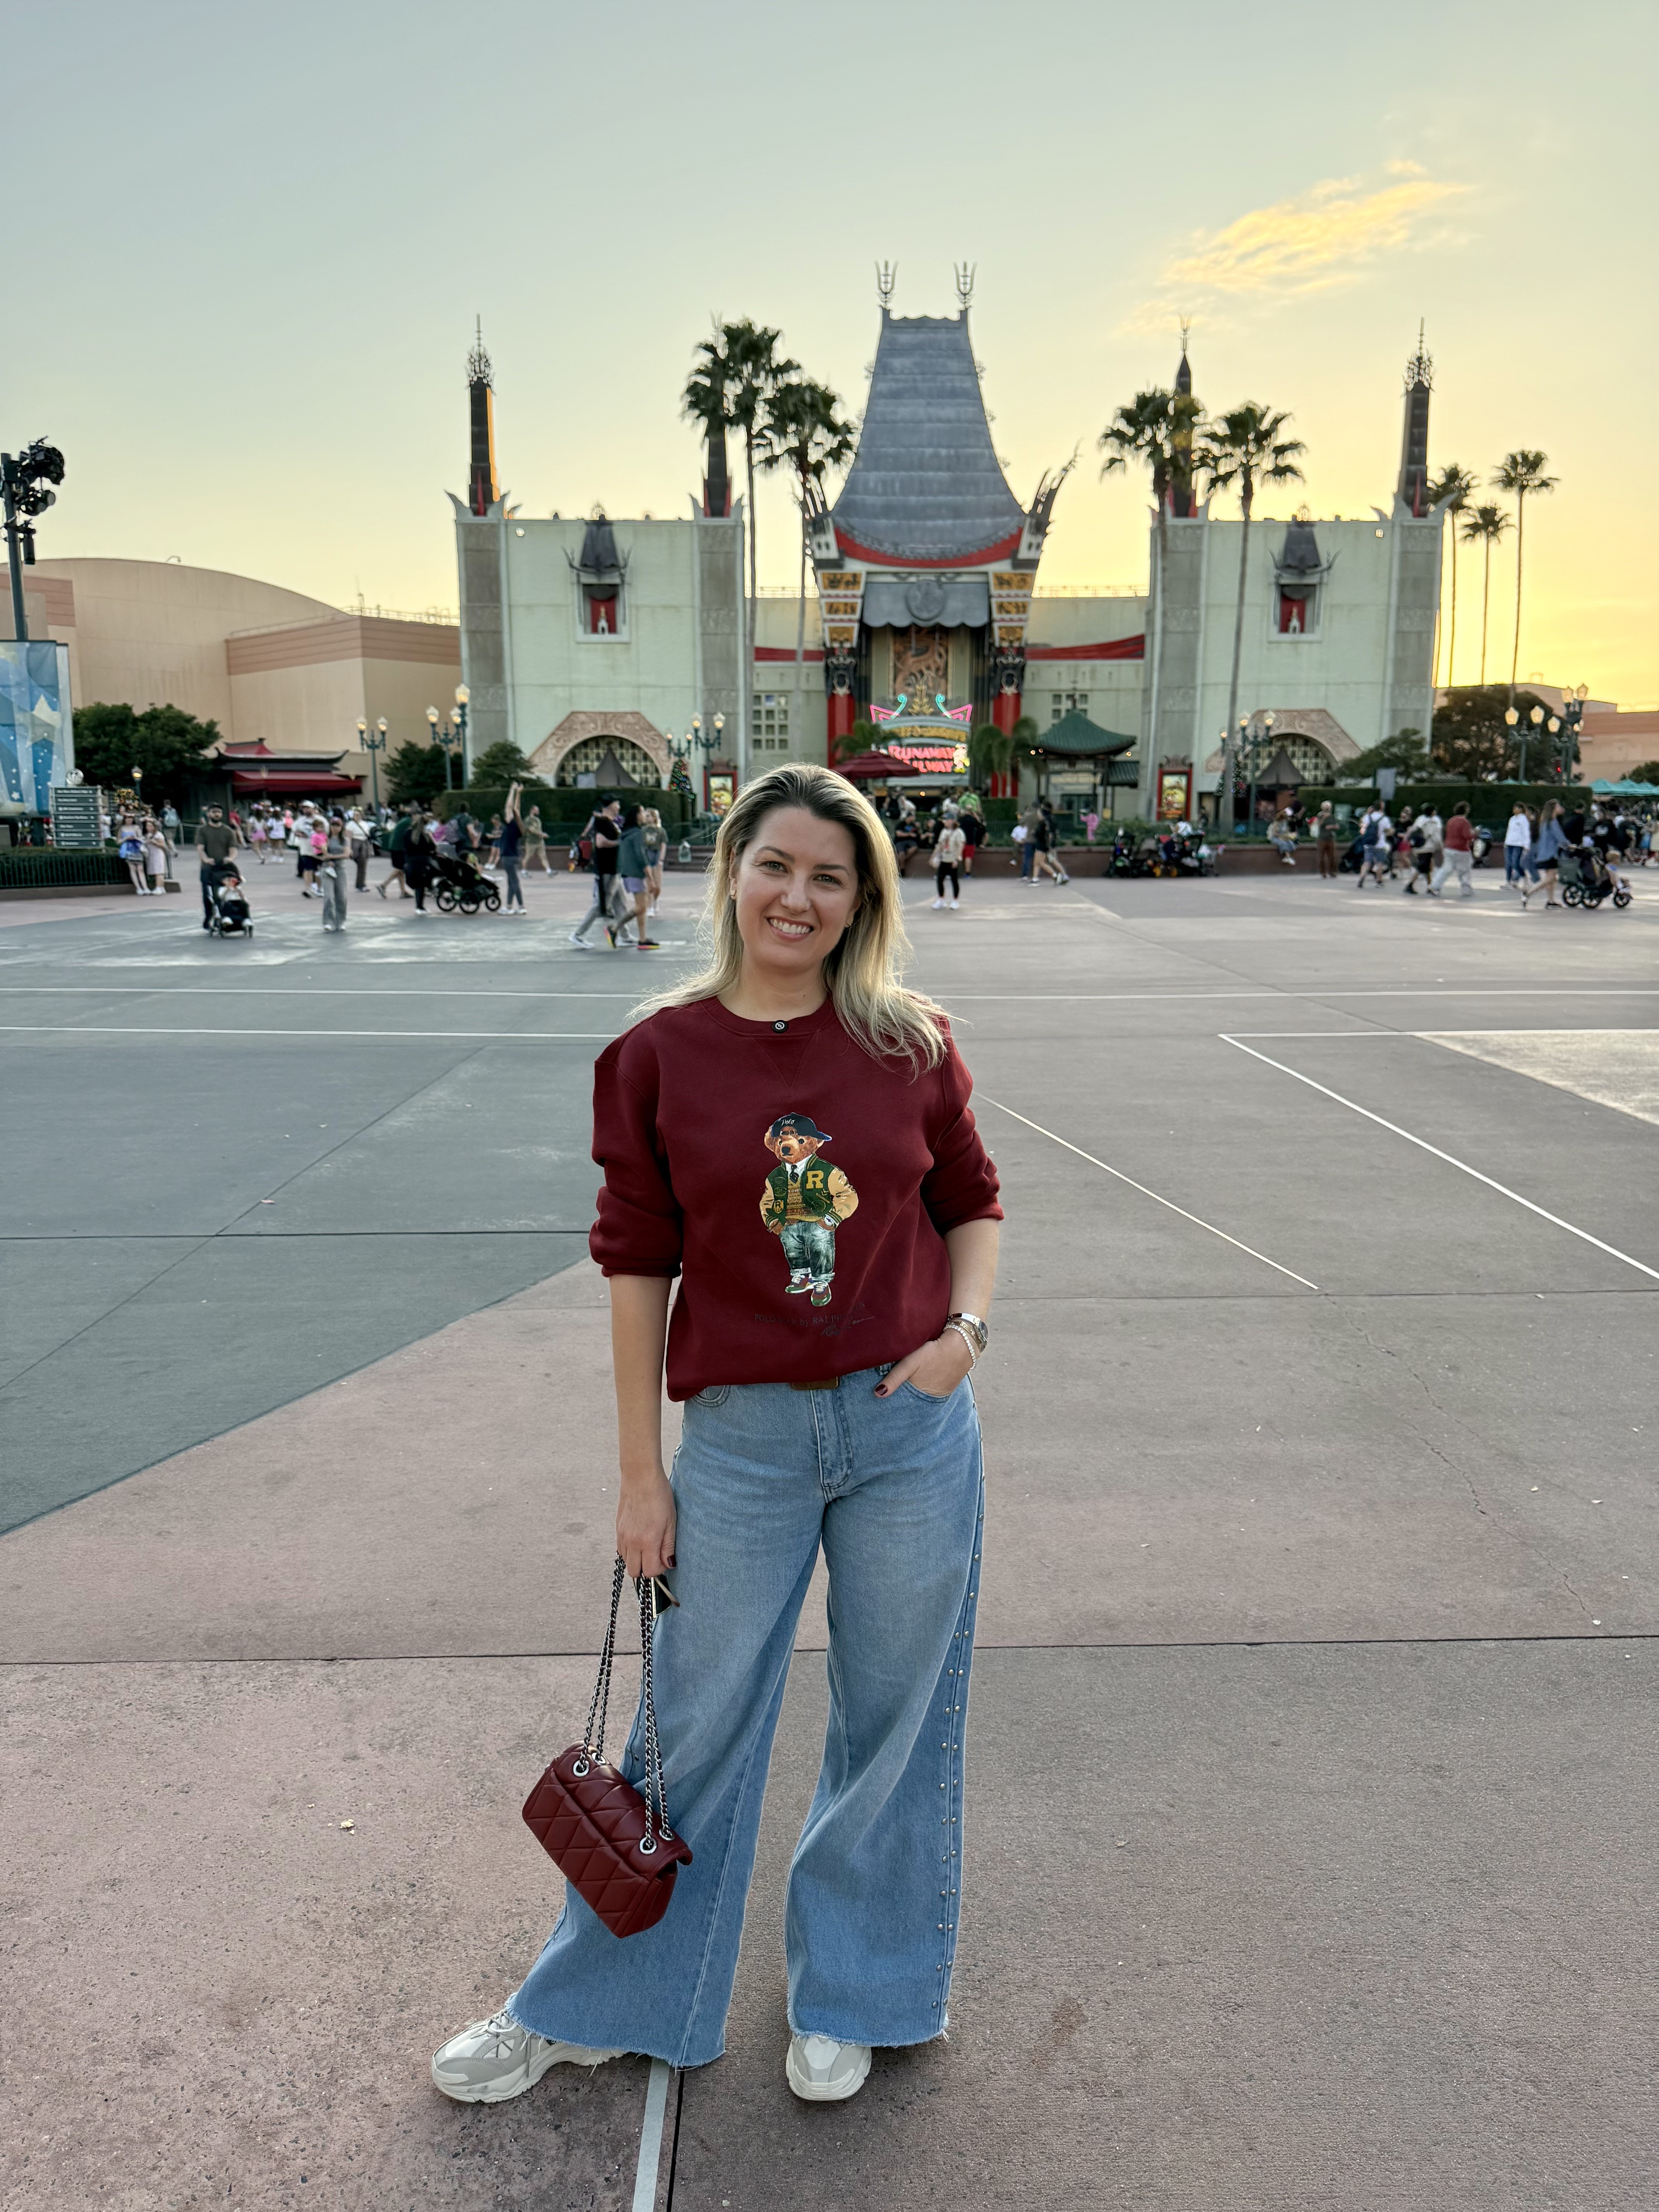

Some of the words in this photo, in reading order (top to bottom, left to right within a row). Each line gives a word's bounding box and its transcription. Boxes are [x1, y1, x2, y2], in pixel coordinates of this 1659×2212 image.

[888, 745, 955, 759] RUNAWAY
[903, 760, 953, 773] ILWAY
[806, 1170, 824, 1189] R
[754, 1313, 776, 1322] POLO
